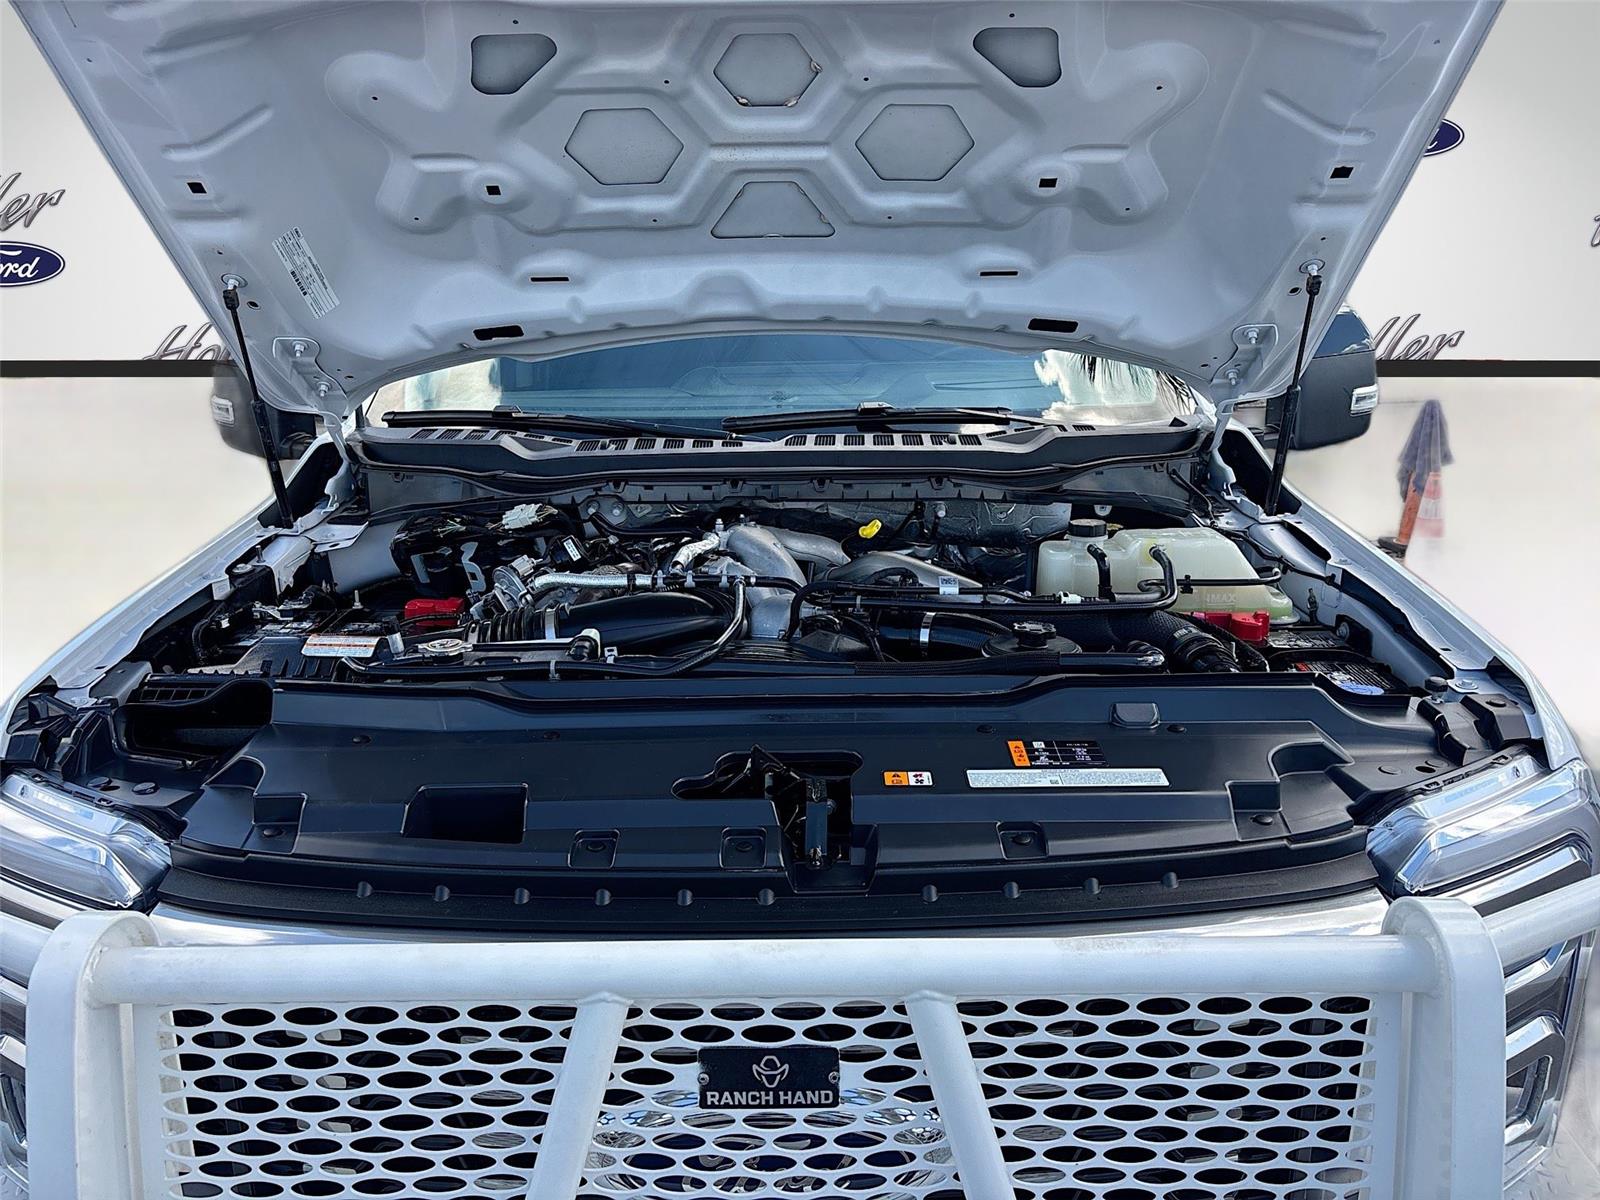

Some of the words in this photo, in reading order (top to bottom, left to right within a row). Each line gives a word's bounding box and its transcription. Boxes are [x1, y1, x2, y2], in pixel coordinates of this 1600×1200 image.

[0, 172, 66, 231] ler
[706, 1091, 774, 1106] RANCH
[779, 1090, 834, 1105] HAND
